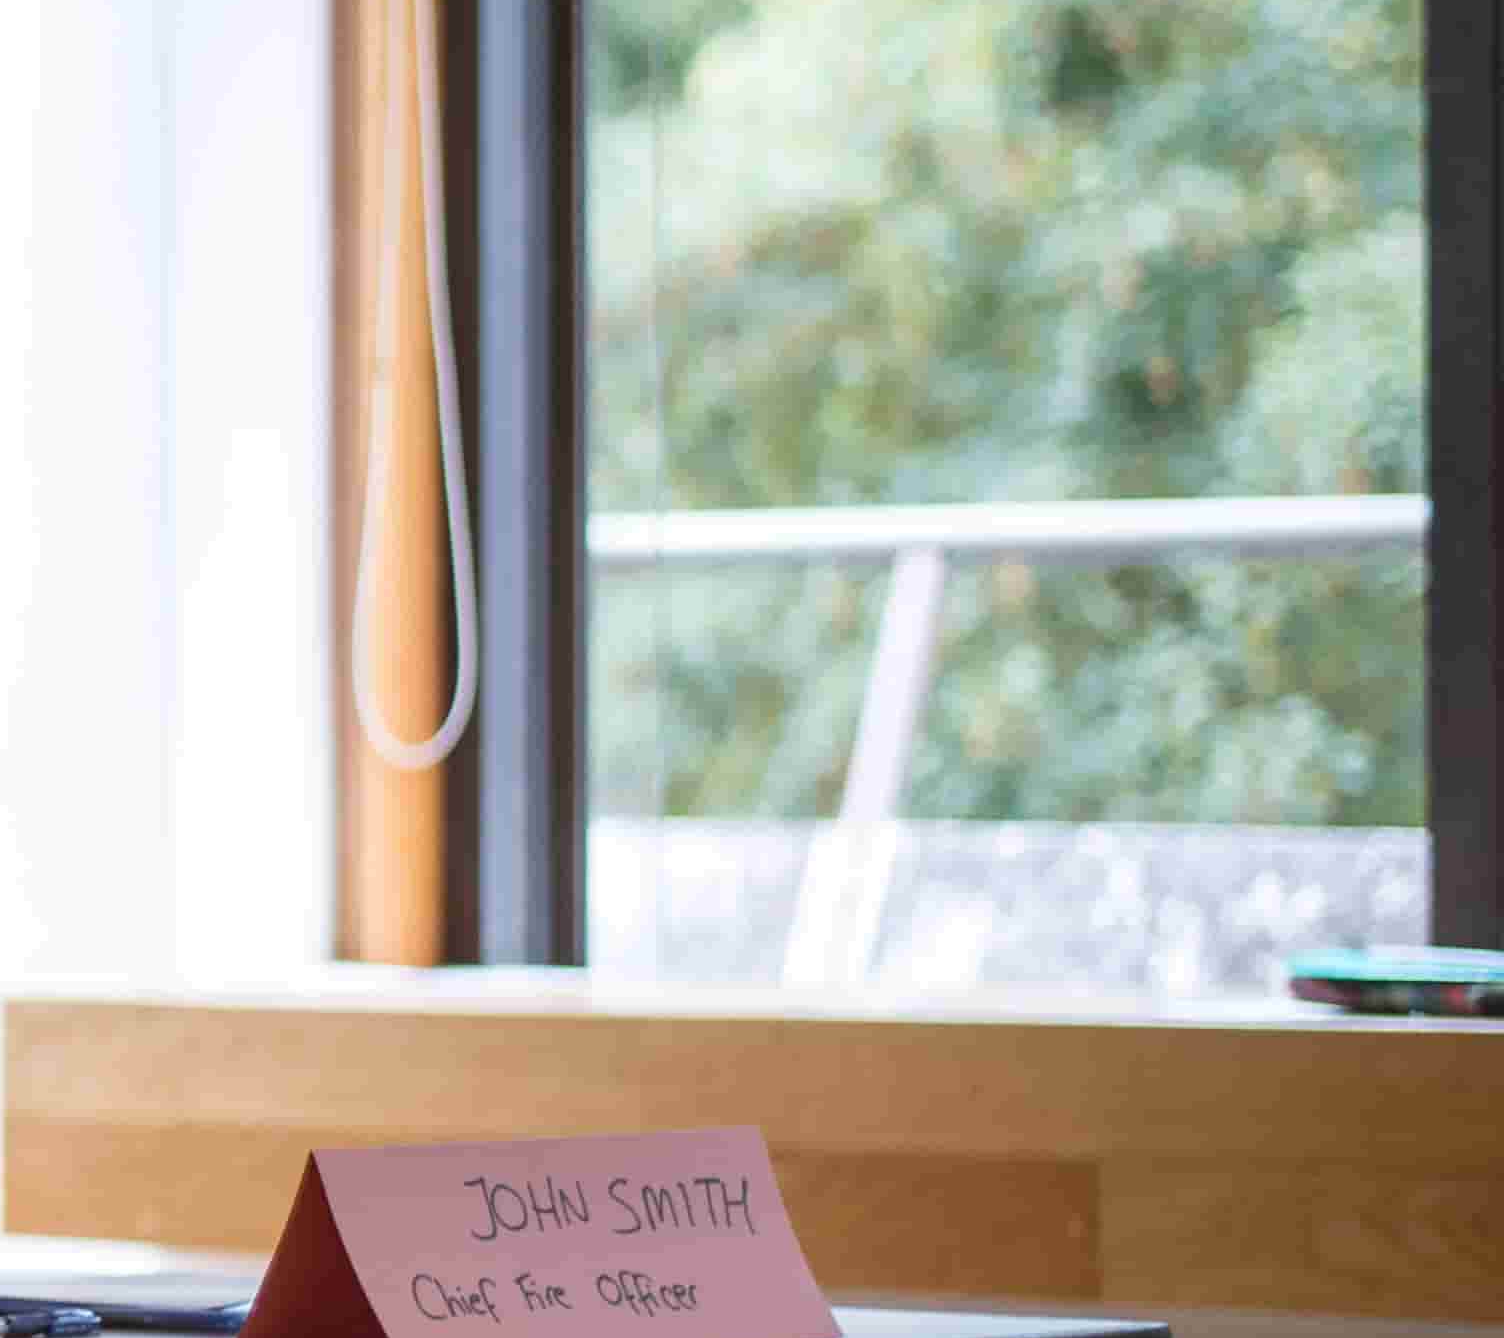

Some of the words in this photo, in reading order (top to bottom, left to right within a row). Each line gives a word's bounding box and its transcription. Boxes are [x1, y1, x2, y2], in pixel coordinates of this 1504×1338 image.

[464, 1177, 589, 1241] JOHN
[608, 1178, 756, 1235] SMITH
[412, 1273, 501, 1323] Chief
[519, 1271, 572, 1314] Fire
[597, 1271, 697, 1318] Officer
